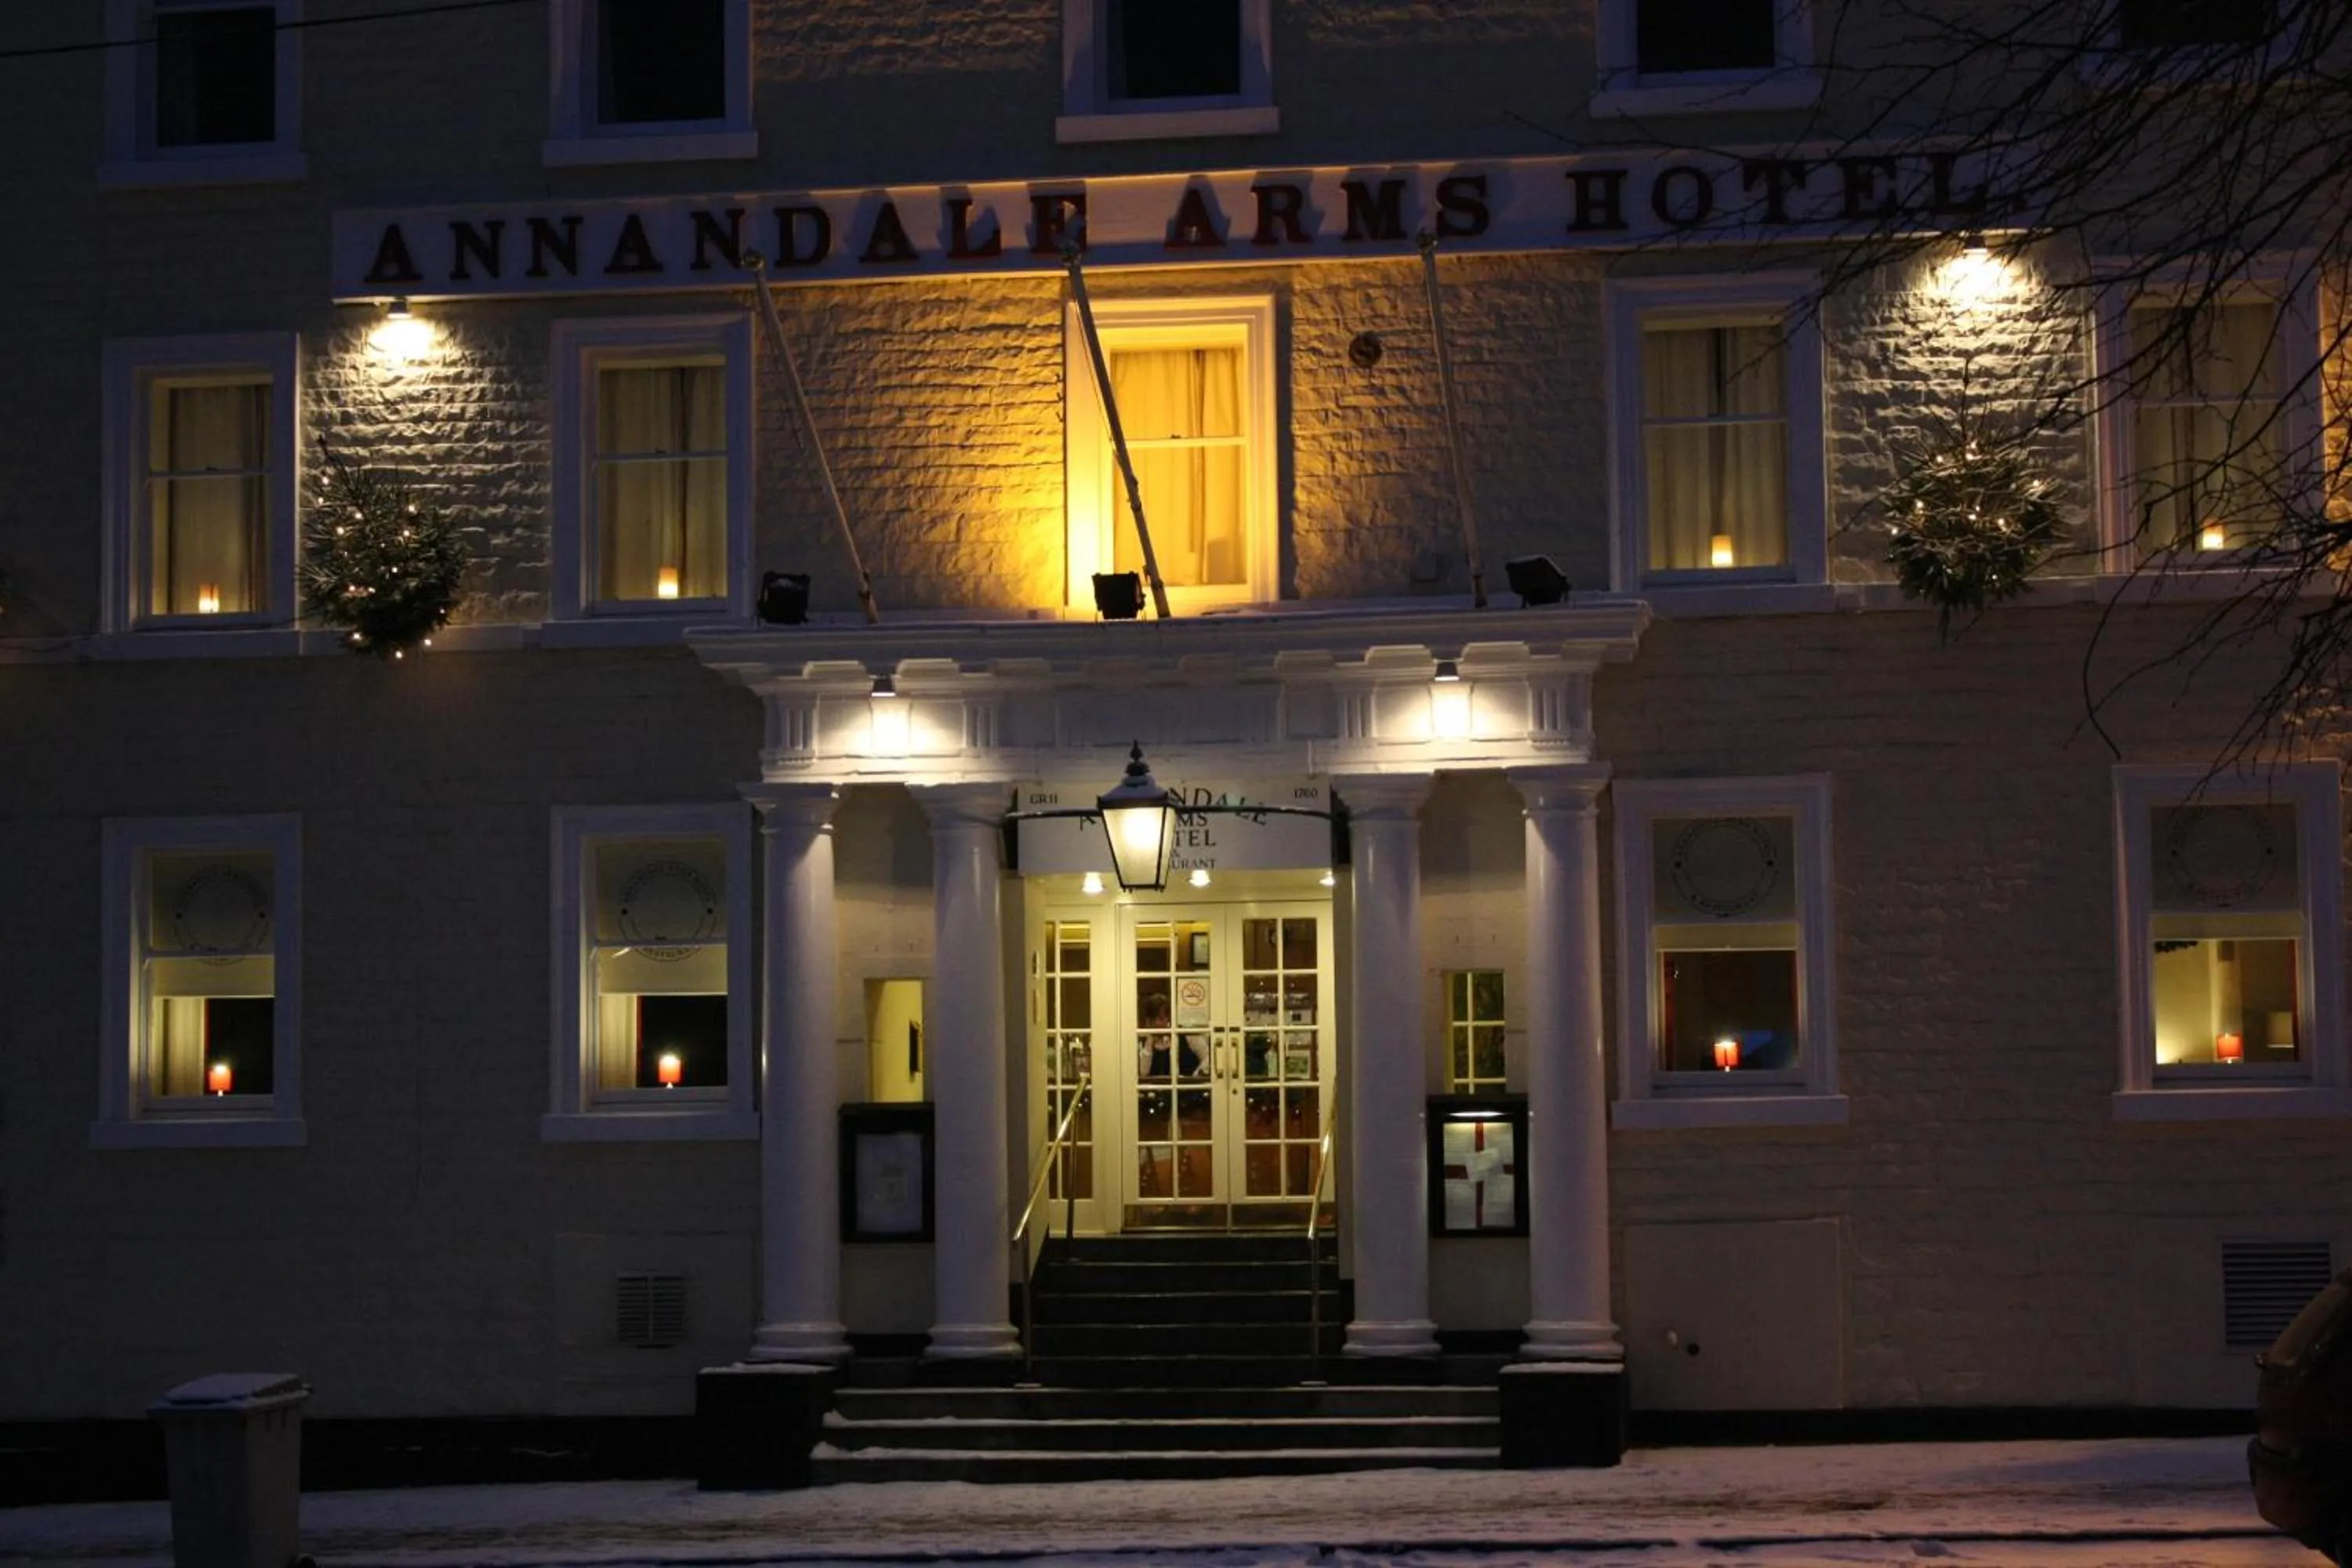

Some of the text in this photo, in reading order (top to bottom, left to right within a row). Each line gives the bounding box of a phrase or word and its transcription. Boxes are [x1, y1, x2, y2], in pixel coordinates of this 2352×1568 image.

[364, 194, 1087, 283] ANNANDALE
[1164, 175, 1489, 248] ARMS
[1177, 811, 1207, 826] MS
[1174, 829, 1217, 847] TEL
